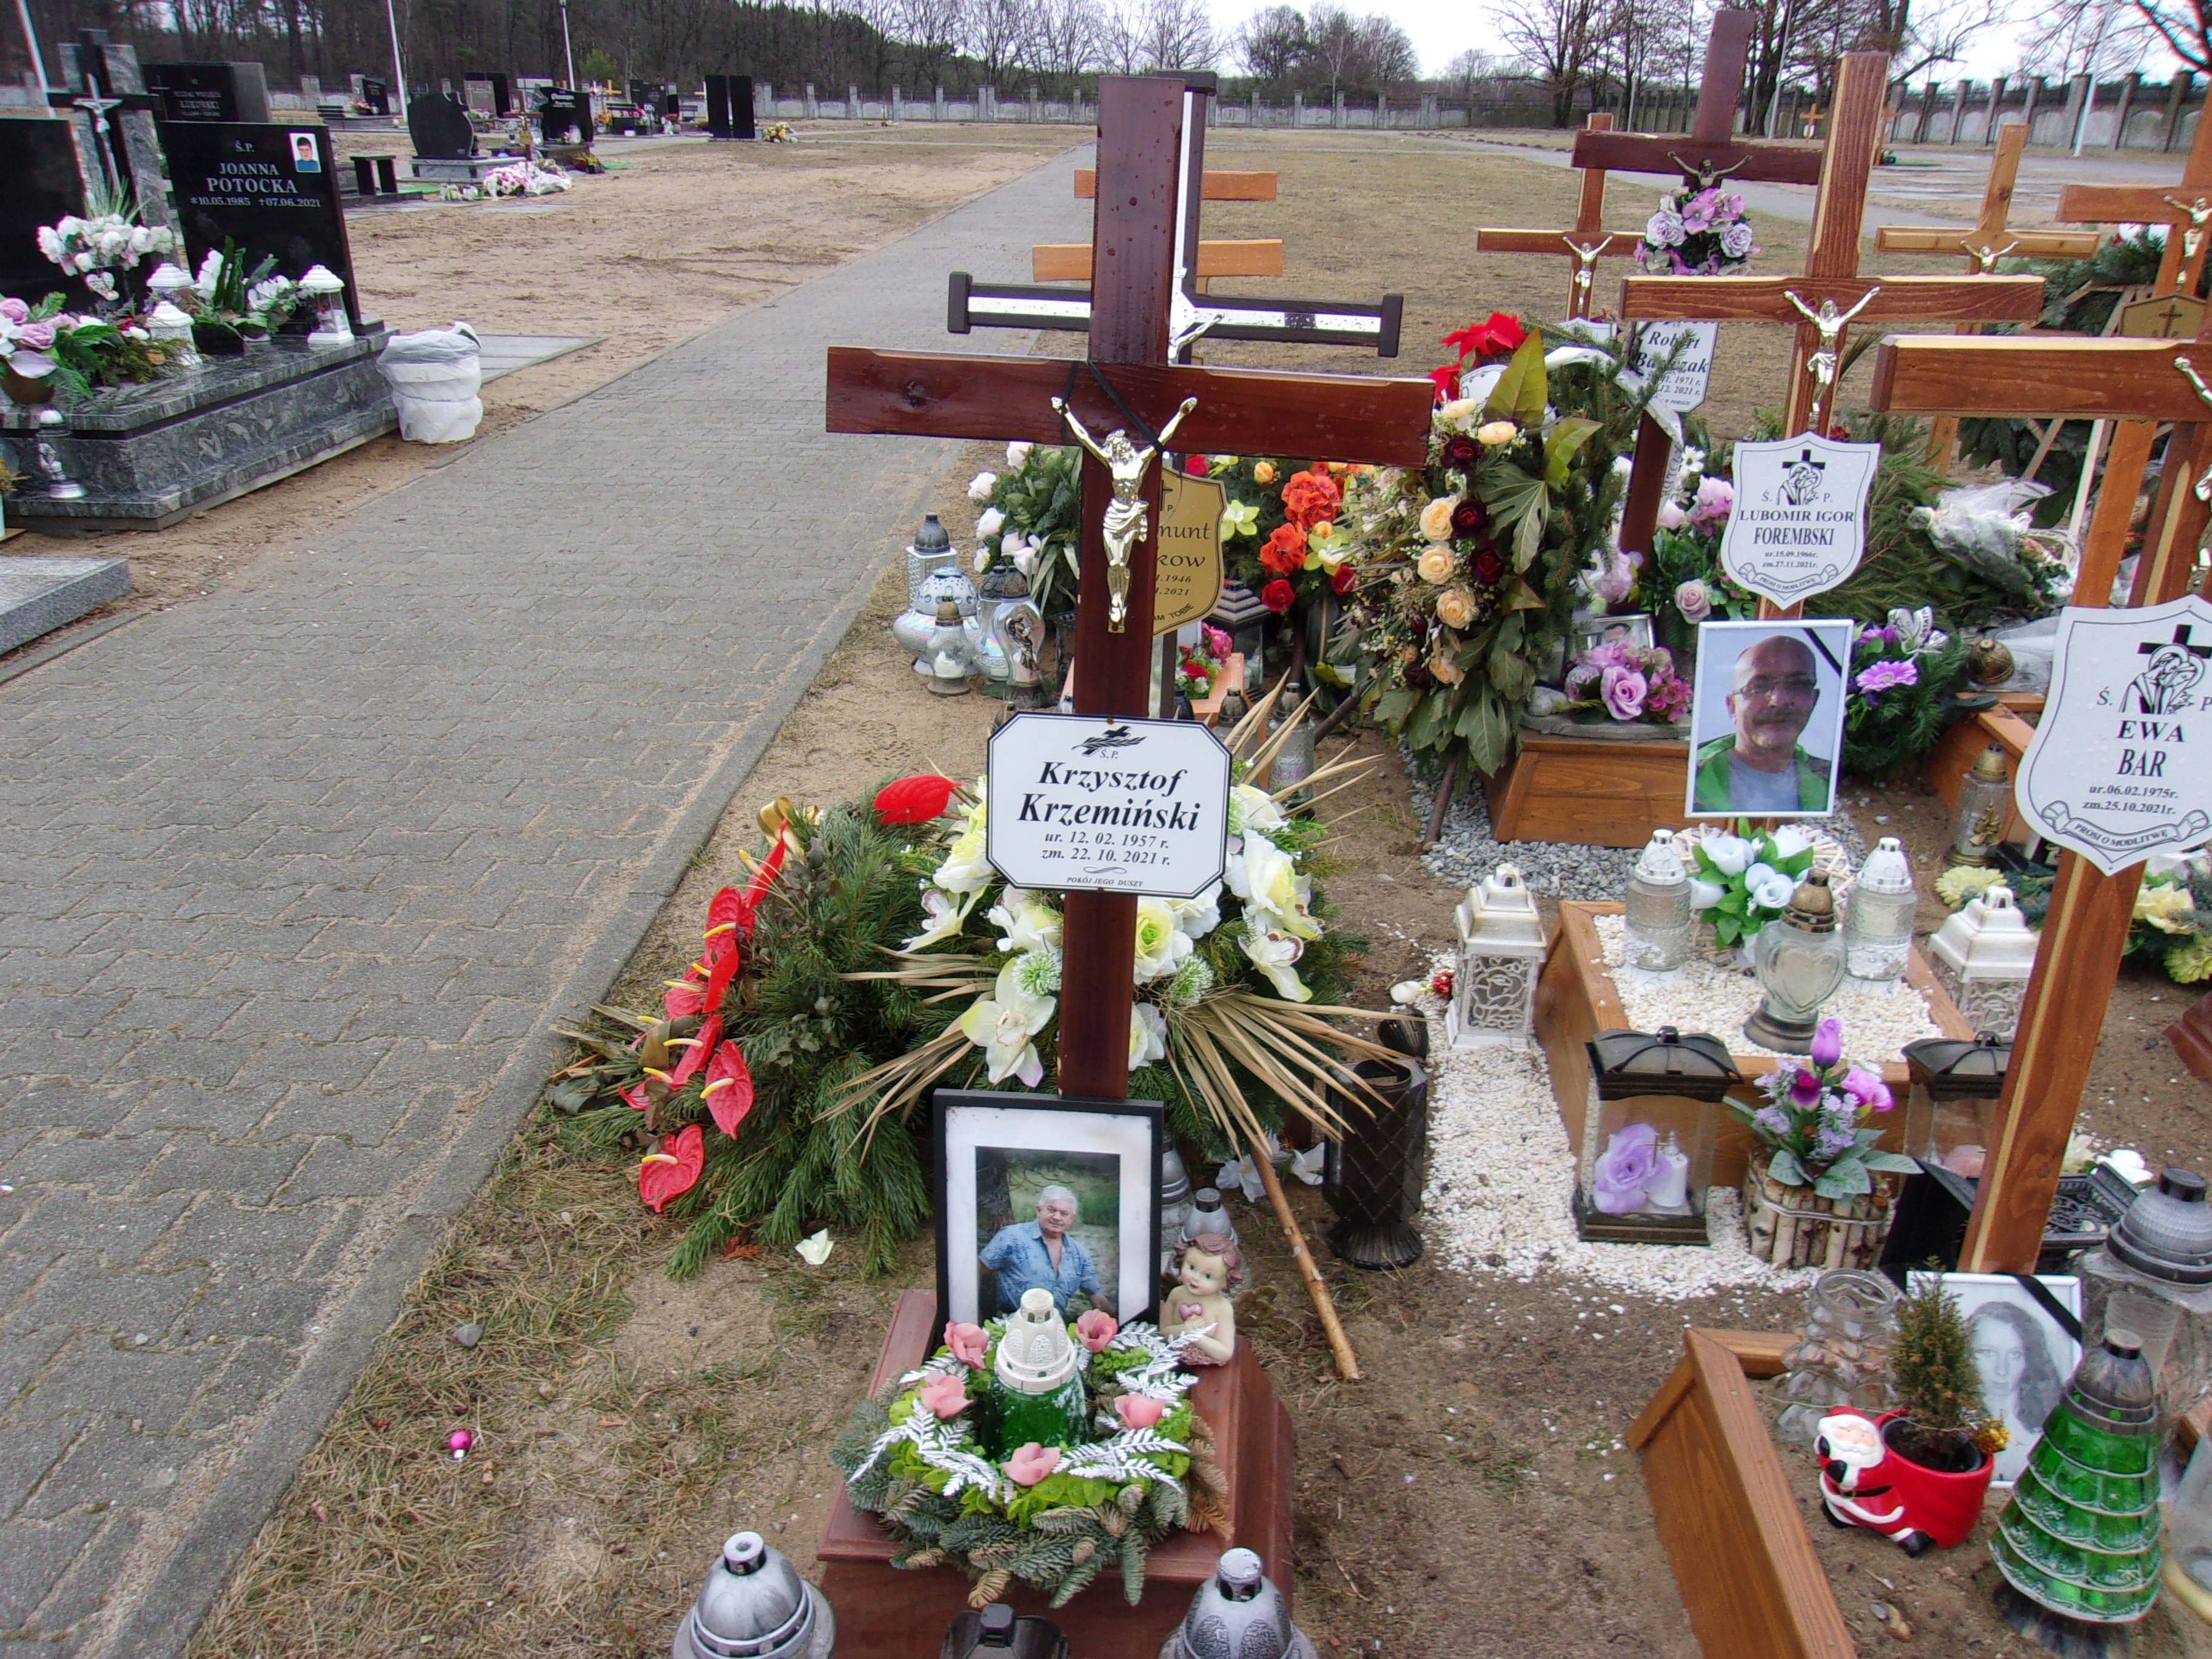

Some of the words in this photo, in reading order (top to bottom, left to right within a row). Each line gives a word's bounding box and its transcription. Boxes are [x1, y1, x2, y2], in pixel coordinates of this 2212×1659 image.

[219, 163, 280, 176] JOANNA
[205, 177, 300, 193] POTOCKA
[1646, 330, 1701, 350] Robrt
[1674, 375, 1694, 385] 1971
[1674, 386, 1694, 395] 2021
[1761, 489, 1772, 503] Ś.
[1822, 492, 1834, 503] P.
[1739, 509, 1812, 522] LUBOMIR
[1815, 510, 1855, 523] IGOR
[1753, 526, 1835, 546] FOREMBSKI
[1167, 602, 1195, 619] TOBIE
[2096, 686, 2113, 706] Ś.
[2115, 720, 2185, 743] EWA
[2115, 748, 2167, 777] BAR
[1036, 760, 1188, 798] Krzysztof
[2088, 784, 2179, 799] ur.06.02.1975r.
[1016, 792, 1201, 831] Krzemiński
[2082, 801, 2176, 815] zm.25.10.2021r.
[1044, 832, 1063, 843] ur.
[1068, 831, 1090, 845] 12.
[1094, 832, 1115, 845] 02.
[1121, 833, 1158, 848] 1957
[1159, 839, 1169, 850] r.
[2073, 822, 2102, 840] PROSI
[2101, 834, 2110, 845] O
[1041, 848, 1065, 860] zm.
[1070, 847, 1091, 860] 22.
[1096, 848, 1118, 862] 10.
[1122, 850, 1158, 865] 2021
[1161, 856, 1171, 866] r.
[1066, 876, 1093, 884] POKÓJ
